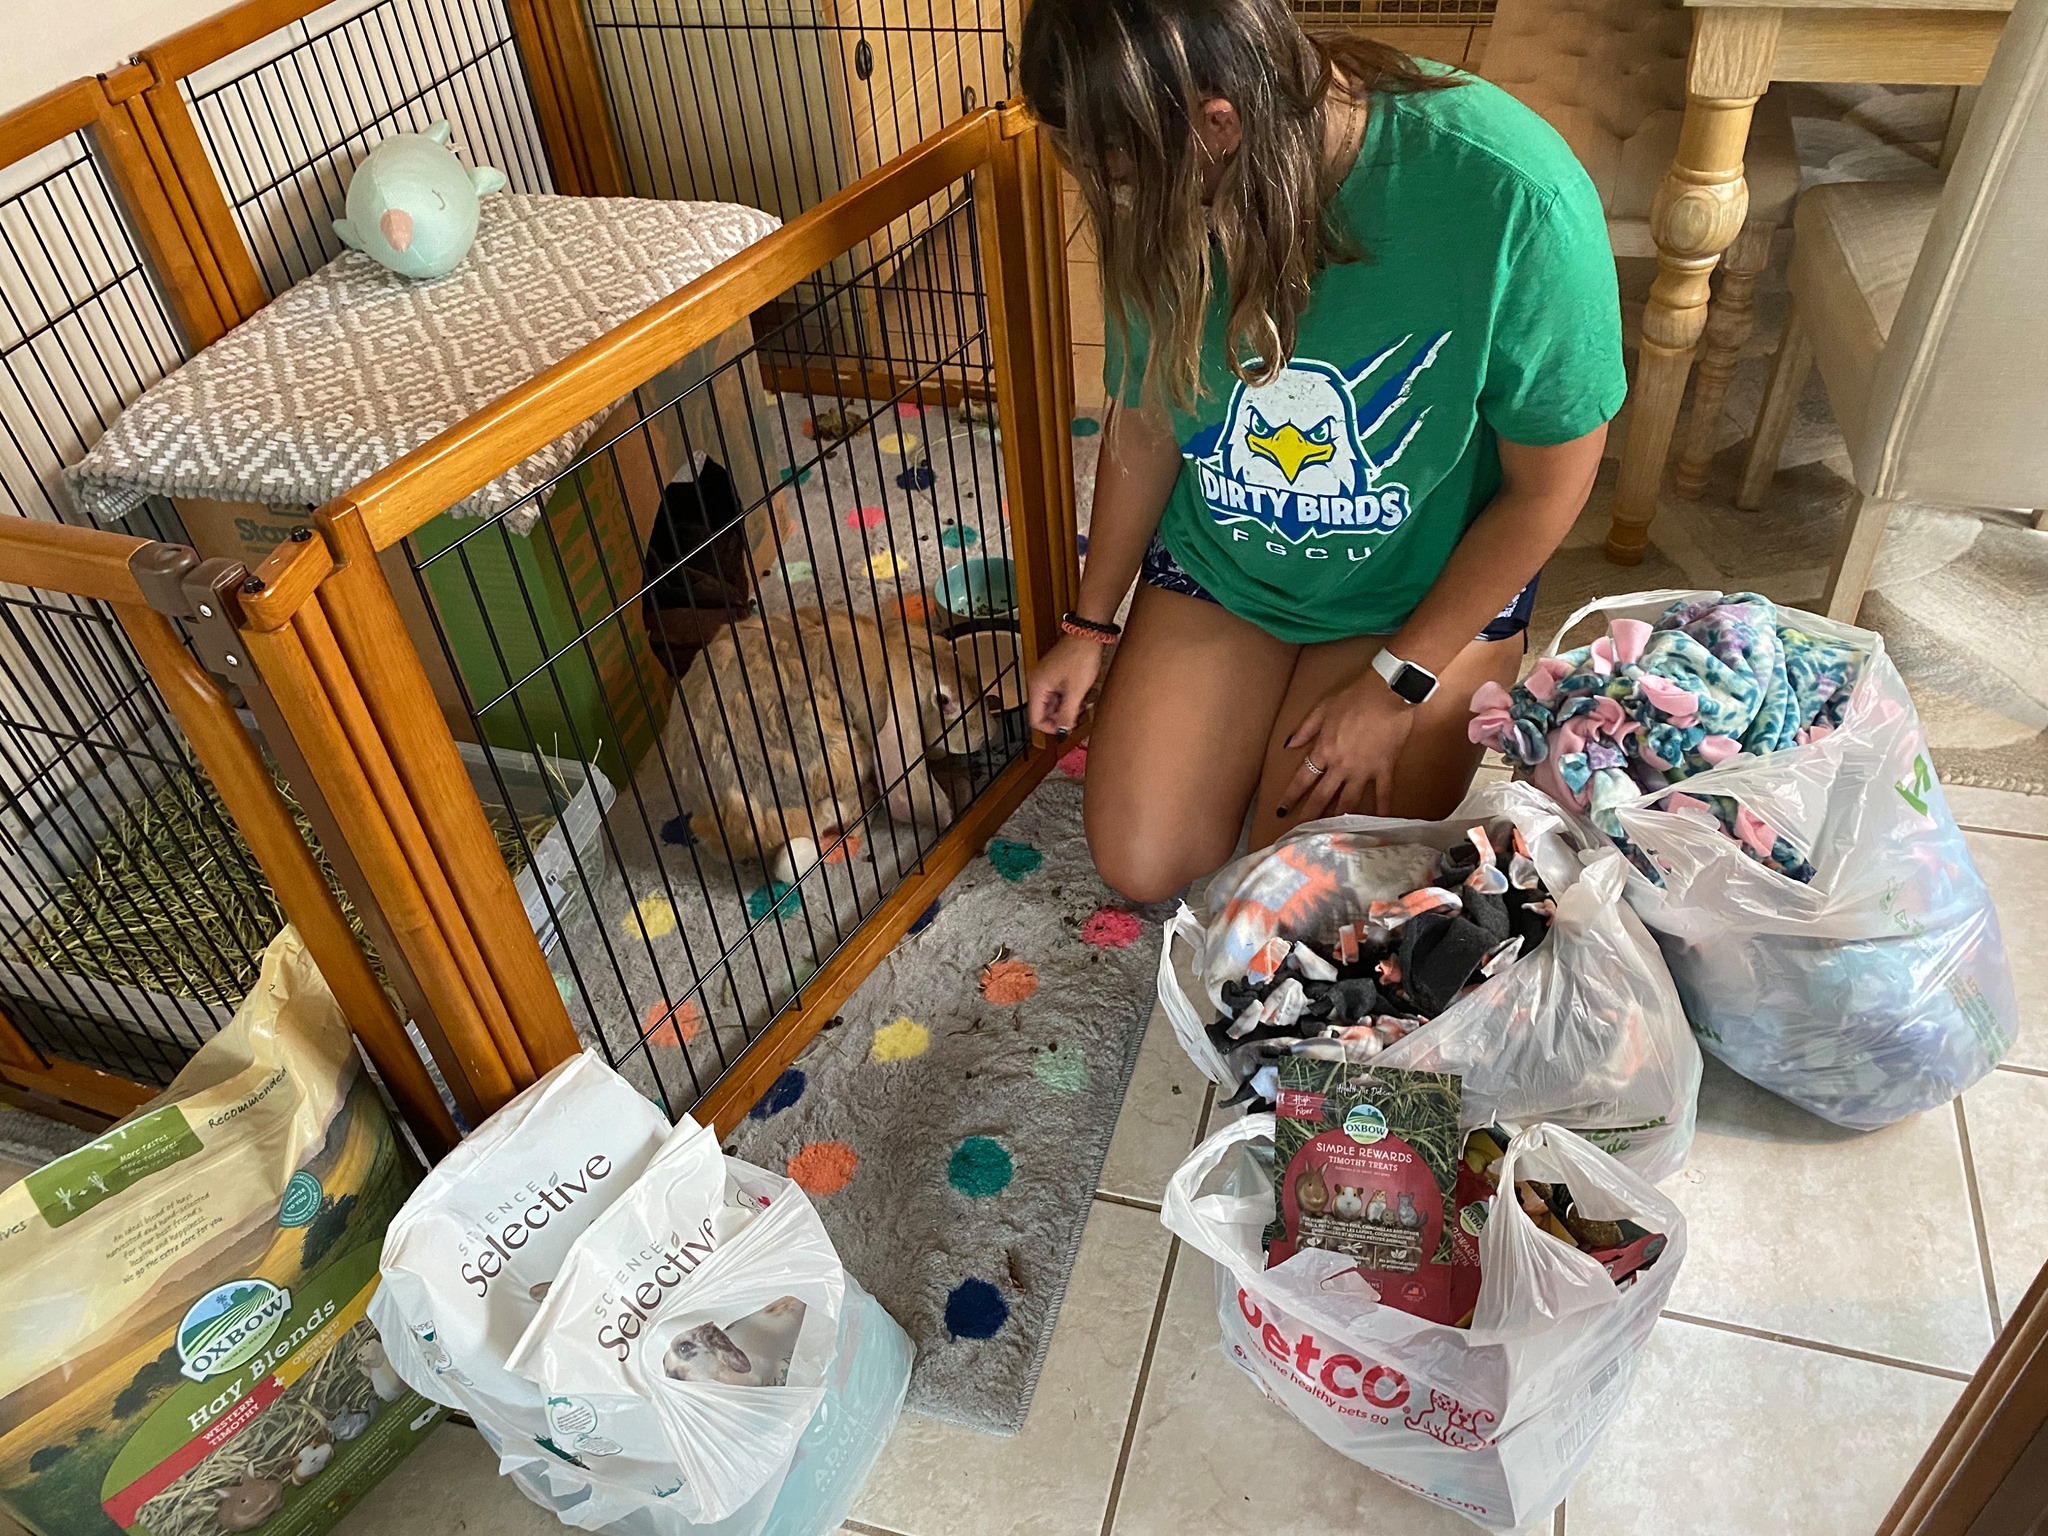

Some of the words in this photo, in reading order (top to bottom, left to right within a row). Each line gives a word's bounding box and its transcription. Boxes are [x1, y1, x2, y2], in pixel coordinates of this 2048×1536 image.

[1204, 467, 1290, 519] DIRTY
[1297, 491, 1402, 526] BIRDS
[208, 1065, 288, 1129] Recommended
[1292, 1094, 1313, 1108] High
[1295, 1107, 1314, 1117] Fiber
[1345, 1123, 1388, 1136] OXBOW
[120, 1148, 141, 1164] More
[120, 1159, 141, 1172] More
[1316, 1142, 1355, 1156] SIMPLE
[1359, 1147, 1412, 1164] REWARDS
[1328, 1155, 1366, 1167] TIMOTHY
[1368, 1160, 1398, 1172] TREATS
[286, 1188, 306, 1206] OMISE
[124, 1221, 144, 1236] ideal
[144, 1207, 165, 1224] blend
[166, 1201, 175, 1211] of
[144, 1224, 158, 1236] and
[461, 1154, 612, 1298] Selective
[1463, 1207, 1484, 1230] OXBO
[123, 1247, 137, 1260] for
[139, 1237, 154, 1251] your
[155, 1225, 172, 1239] best
[129, 1249, 154, 1267] health
[155, 1238, 169, 1251] and
[135, 1267, 145, 1279] go
[146, 1258, 159, 1270] the
[160, 1244, 179, 1261] extra
[181, 1234, 197, 1248] acre
[197, 1224, 209, 1237] for
[595, 1240, 664, 1319] SCENCE
[191, 1295, 284, 1373] OXBOW
[220, 1344, 248, 1368] ANIMAL
[248, 1320, 276, 1345] HEALTH
[292, 1320, 340, 1366] ORCHARD
[305, 1334, 338, 1364] GRASS
[187, 1378, 243, 1432] Hay
[249, 1299, 336, 1381] Blends
[1290, 1372, 1336, 1408] healthy
[1338, 1404, 1367, 1420] pets
[1371, 1413, 1389, 1425] go
[202, 1396, 255, 1441] WESTERN
[208, 1402, 260, 1446] TIMOTHY
